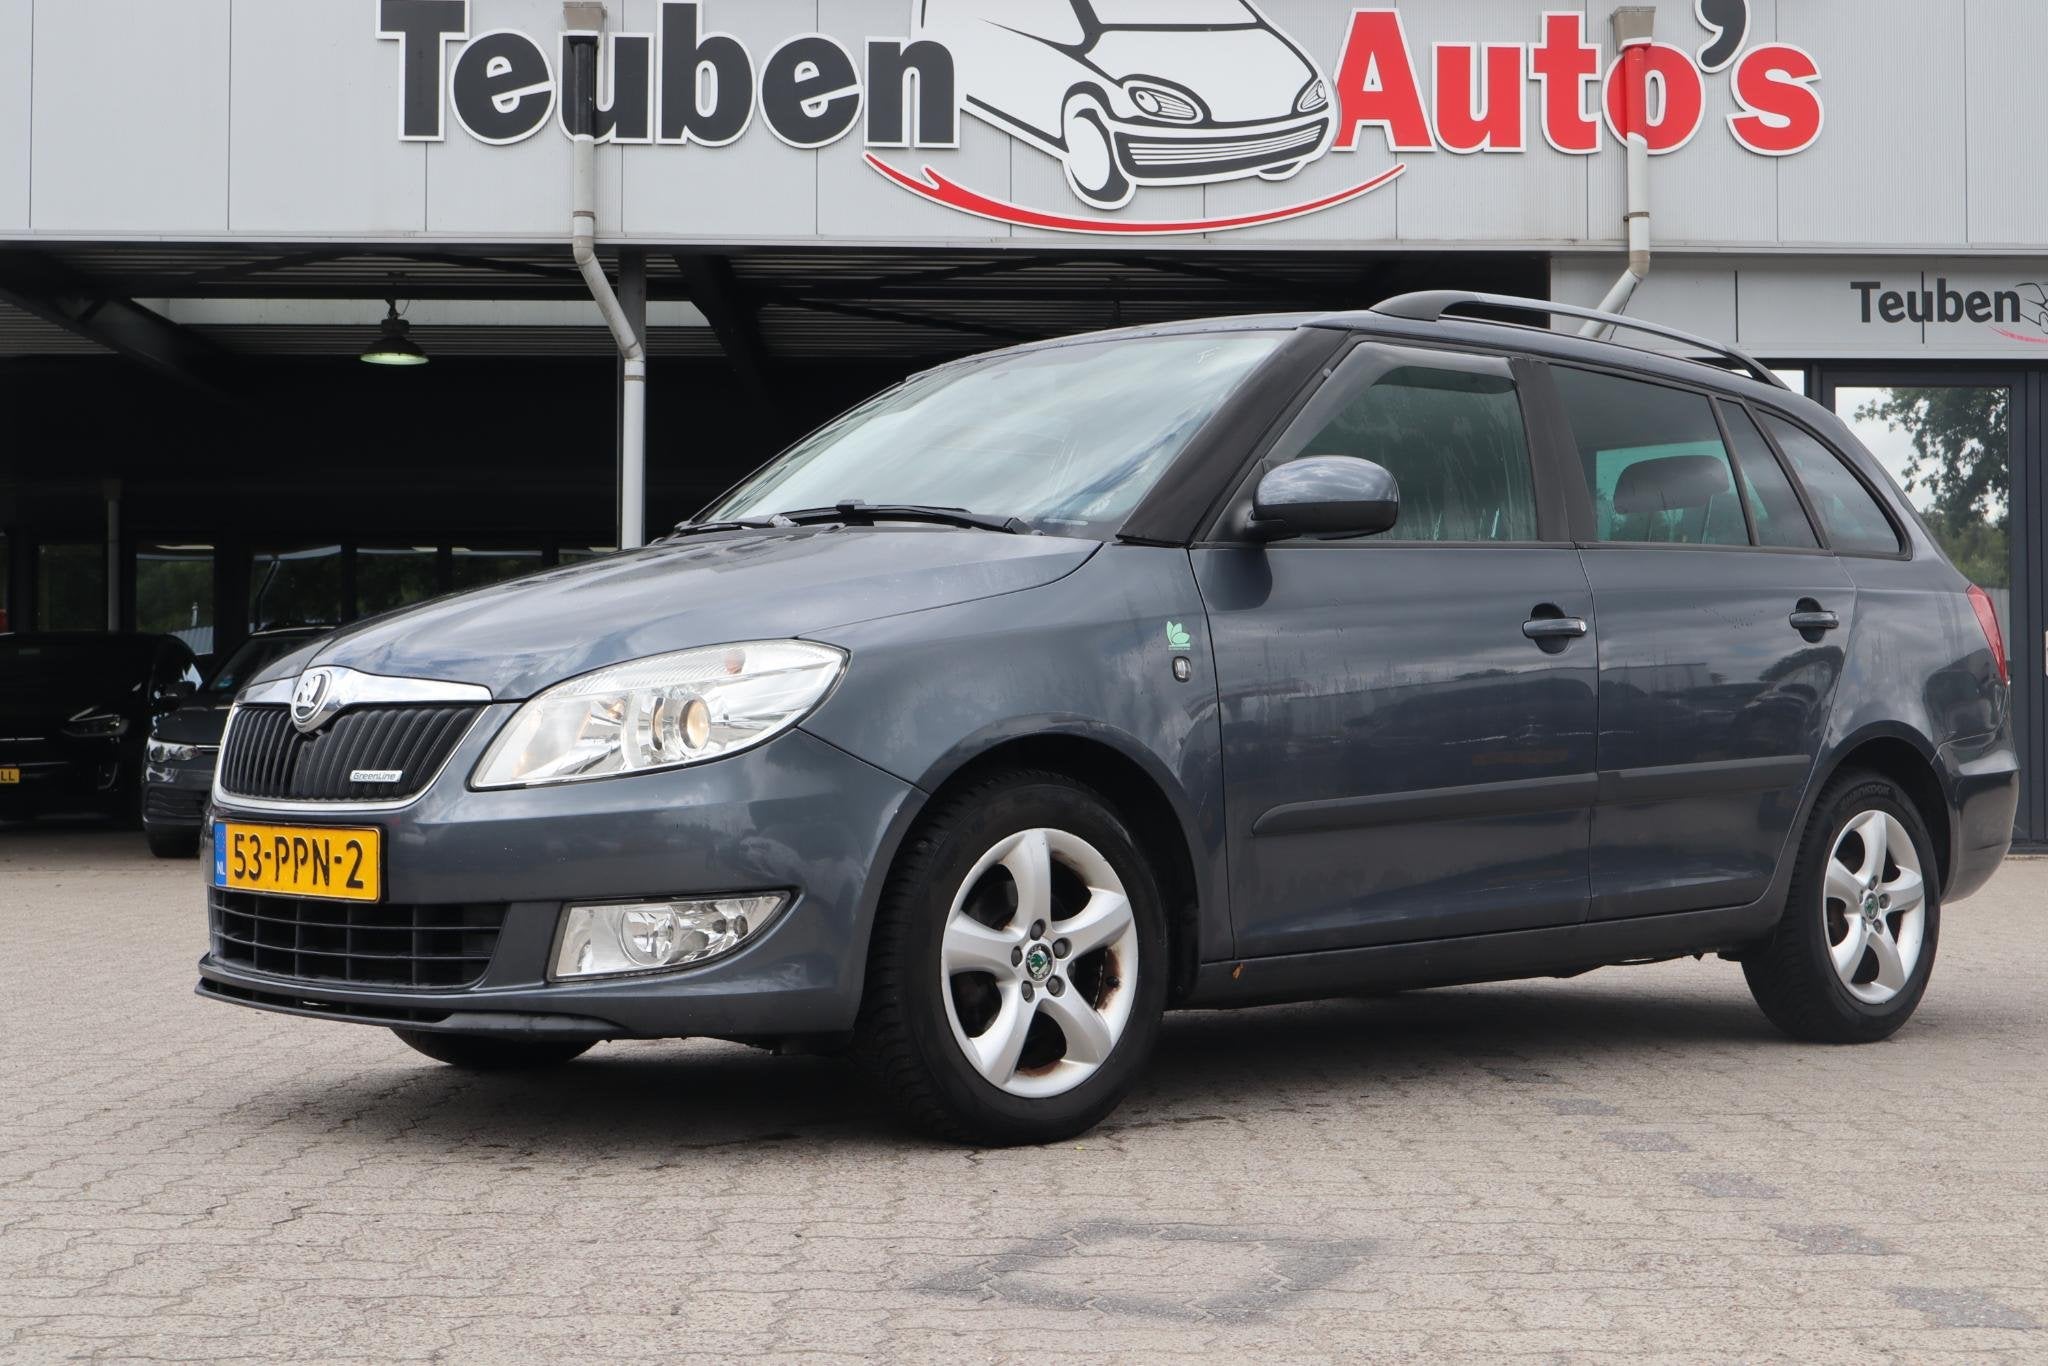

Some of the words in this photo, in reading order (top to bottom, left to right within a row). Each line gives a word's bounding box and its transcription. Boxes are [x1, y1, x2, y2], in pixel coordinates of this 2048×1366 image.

[378, 0, 957, 147] Teuben
[1332, 0, 1823, 155] Auto's
[1850, 277, 2021, 323] Teuben
[216, 861, 226, 876] NL
[234, 833, 364, 889] 53-PPN-2
